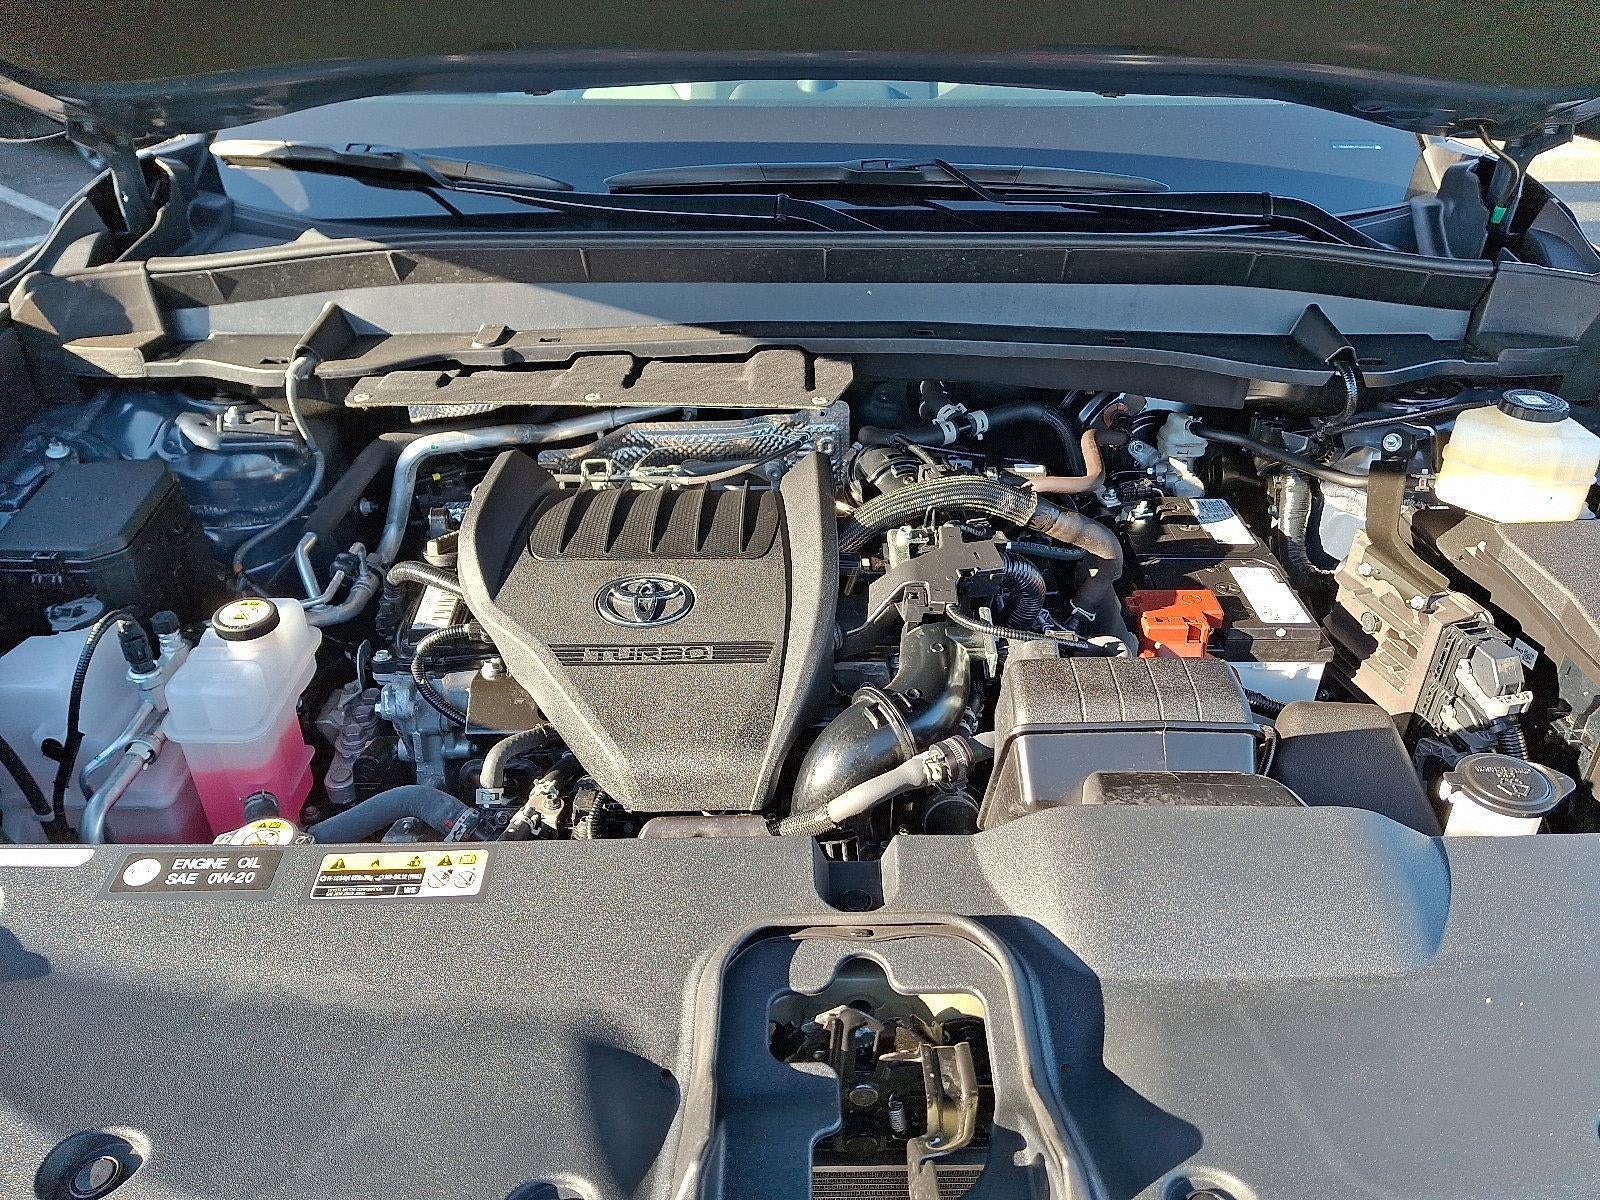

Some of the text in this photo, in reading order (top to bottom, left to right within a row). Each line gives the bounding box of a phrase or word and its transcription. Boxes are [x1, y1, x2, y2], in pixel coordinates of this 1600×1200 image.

[587, 646, 710, 661] TURBO
[171, 856, 261, 870] ENGINE OIL
[164, 871, 256, 885] SAE 0W-20
